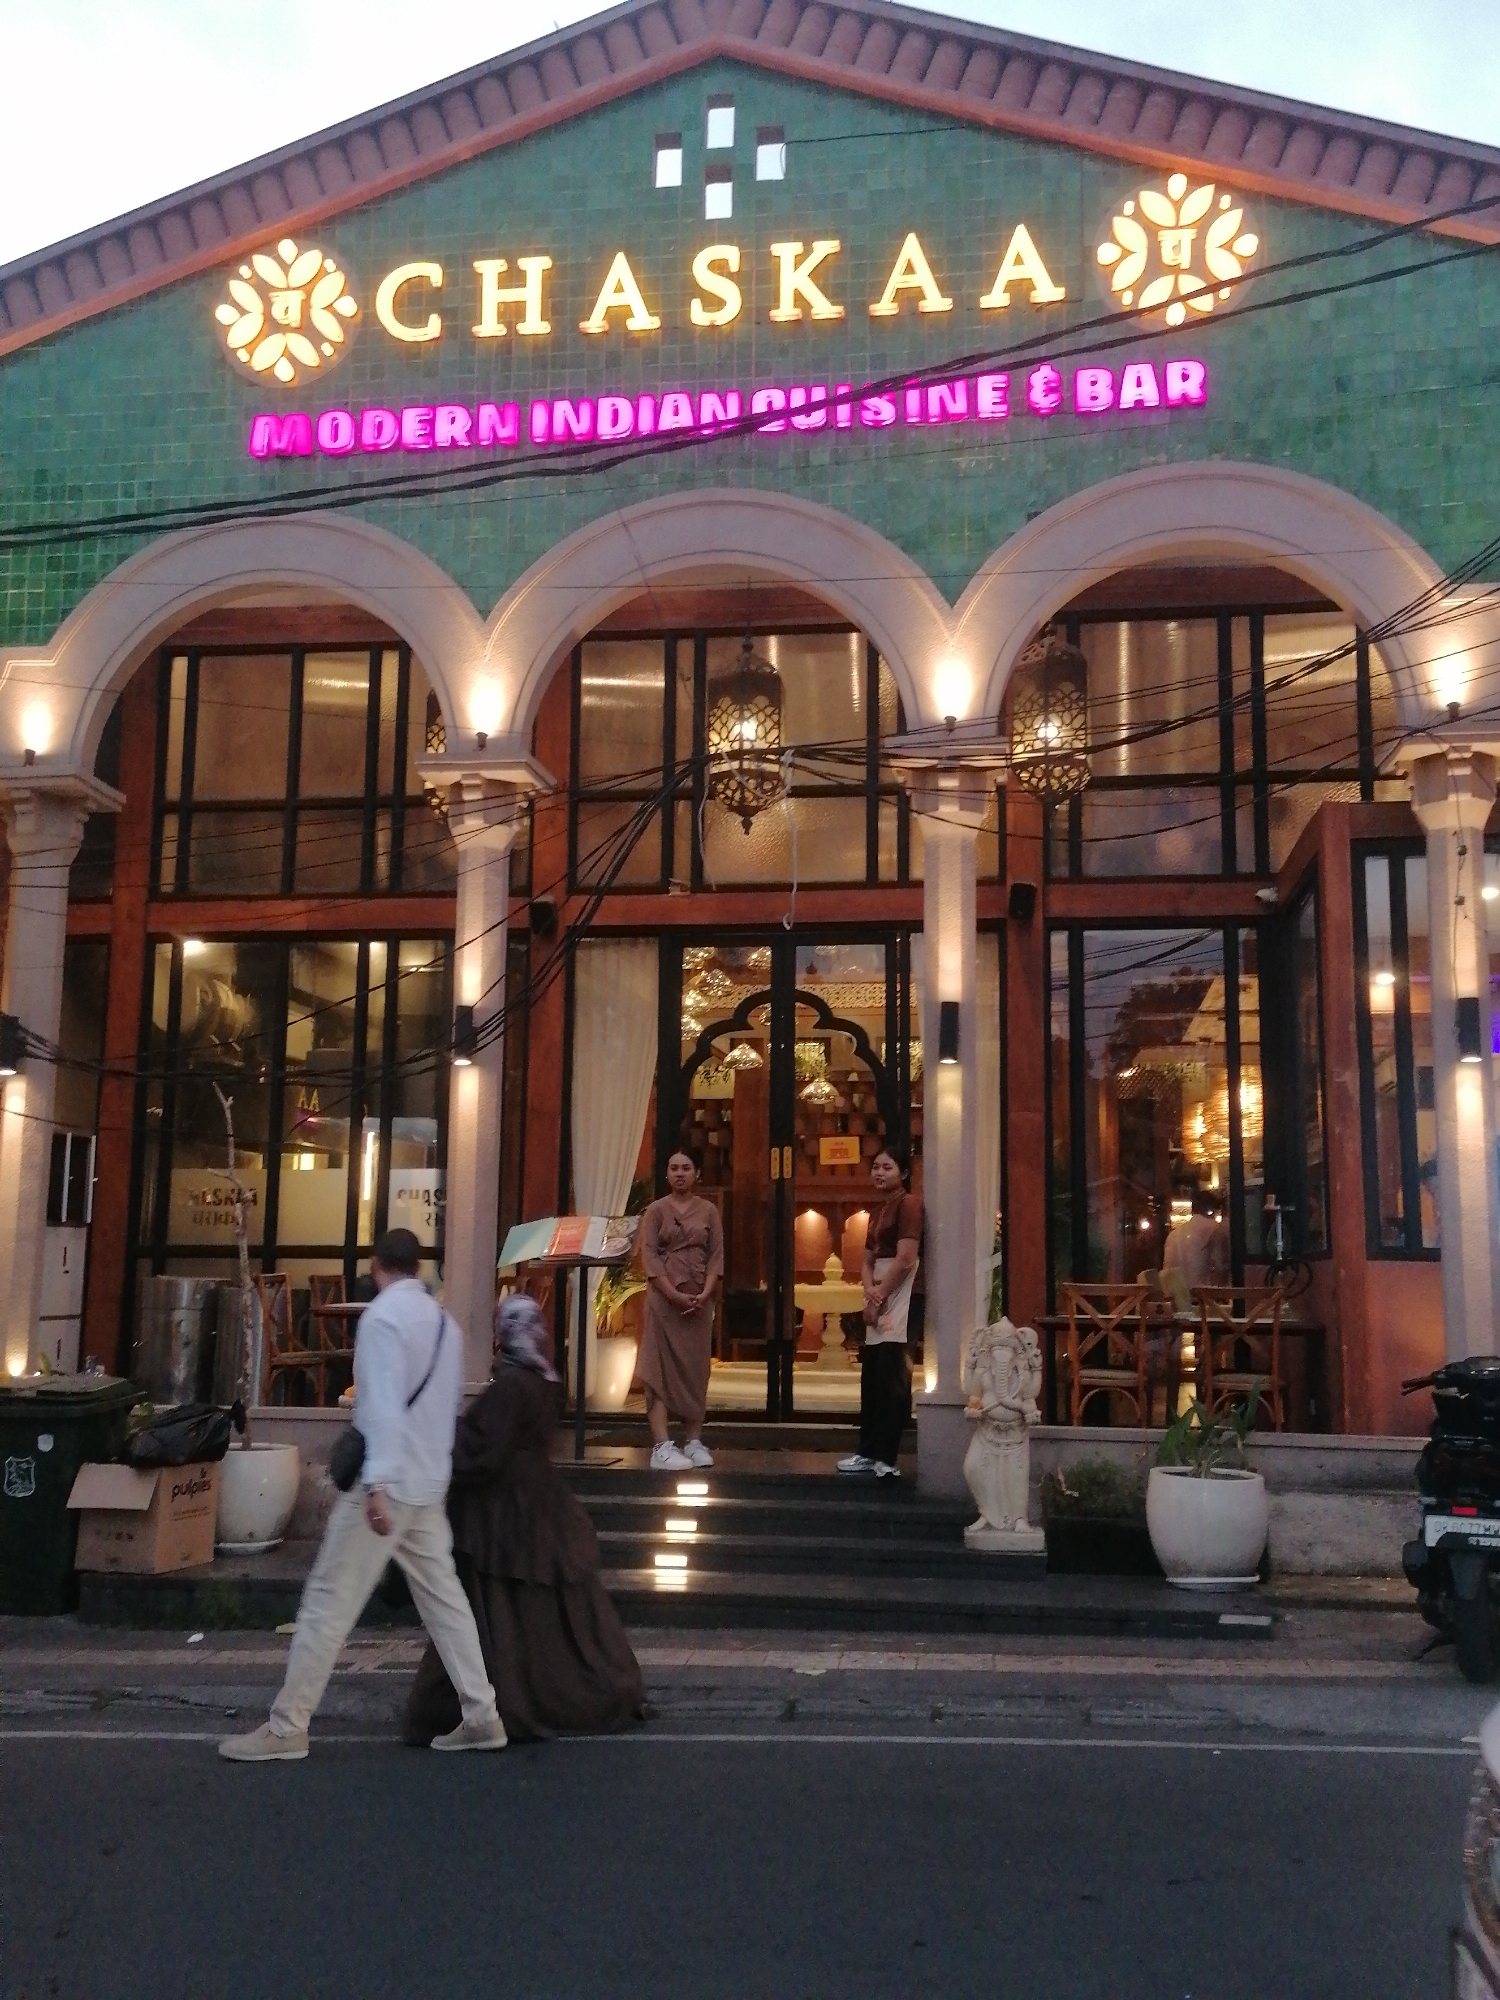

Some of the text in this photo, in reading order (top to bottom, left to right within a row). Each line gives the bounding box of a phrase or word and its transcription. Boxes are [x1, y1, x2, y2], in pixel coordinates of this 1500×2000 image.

[375, 223, 1066, 342] CHASKAA
[249, 358, 1207, 459] MODERN INDIAN CUISINE & BAR
